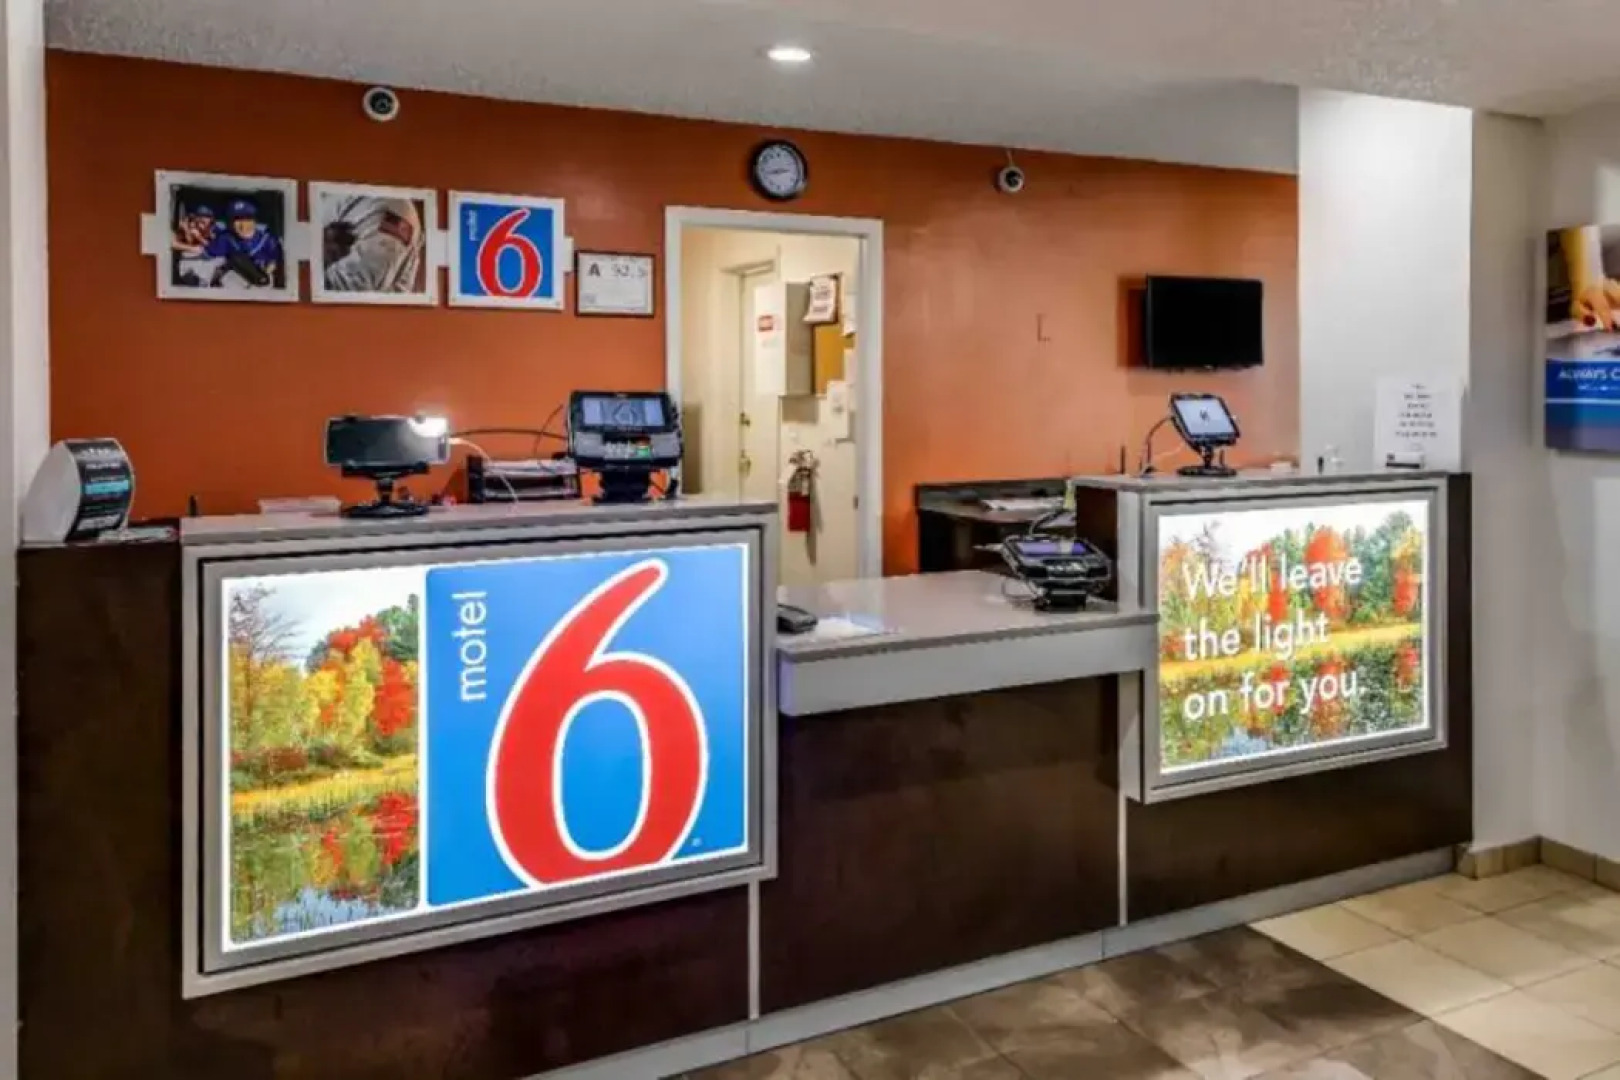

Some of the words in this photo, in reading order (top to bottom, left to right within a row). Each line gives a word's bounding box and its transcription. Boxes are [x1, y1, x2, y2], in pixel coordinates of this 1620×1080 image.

[477, 207, 543, 298] 6
[1182, 555, 1270, 600] We'll
[1280, 553, 1363, 590] leave
[1184, 617, 1241, 661] the
[1254, 608, 1330, 661] light
[1184, 689, 1228, 721] on
[1240, 671, 1290, 714] for
[1301, 671, 1366, 714] you.
[452, 591, 487, 702] motel
[486, 558, 709, 888] 6
